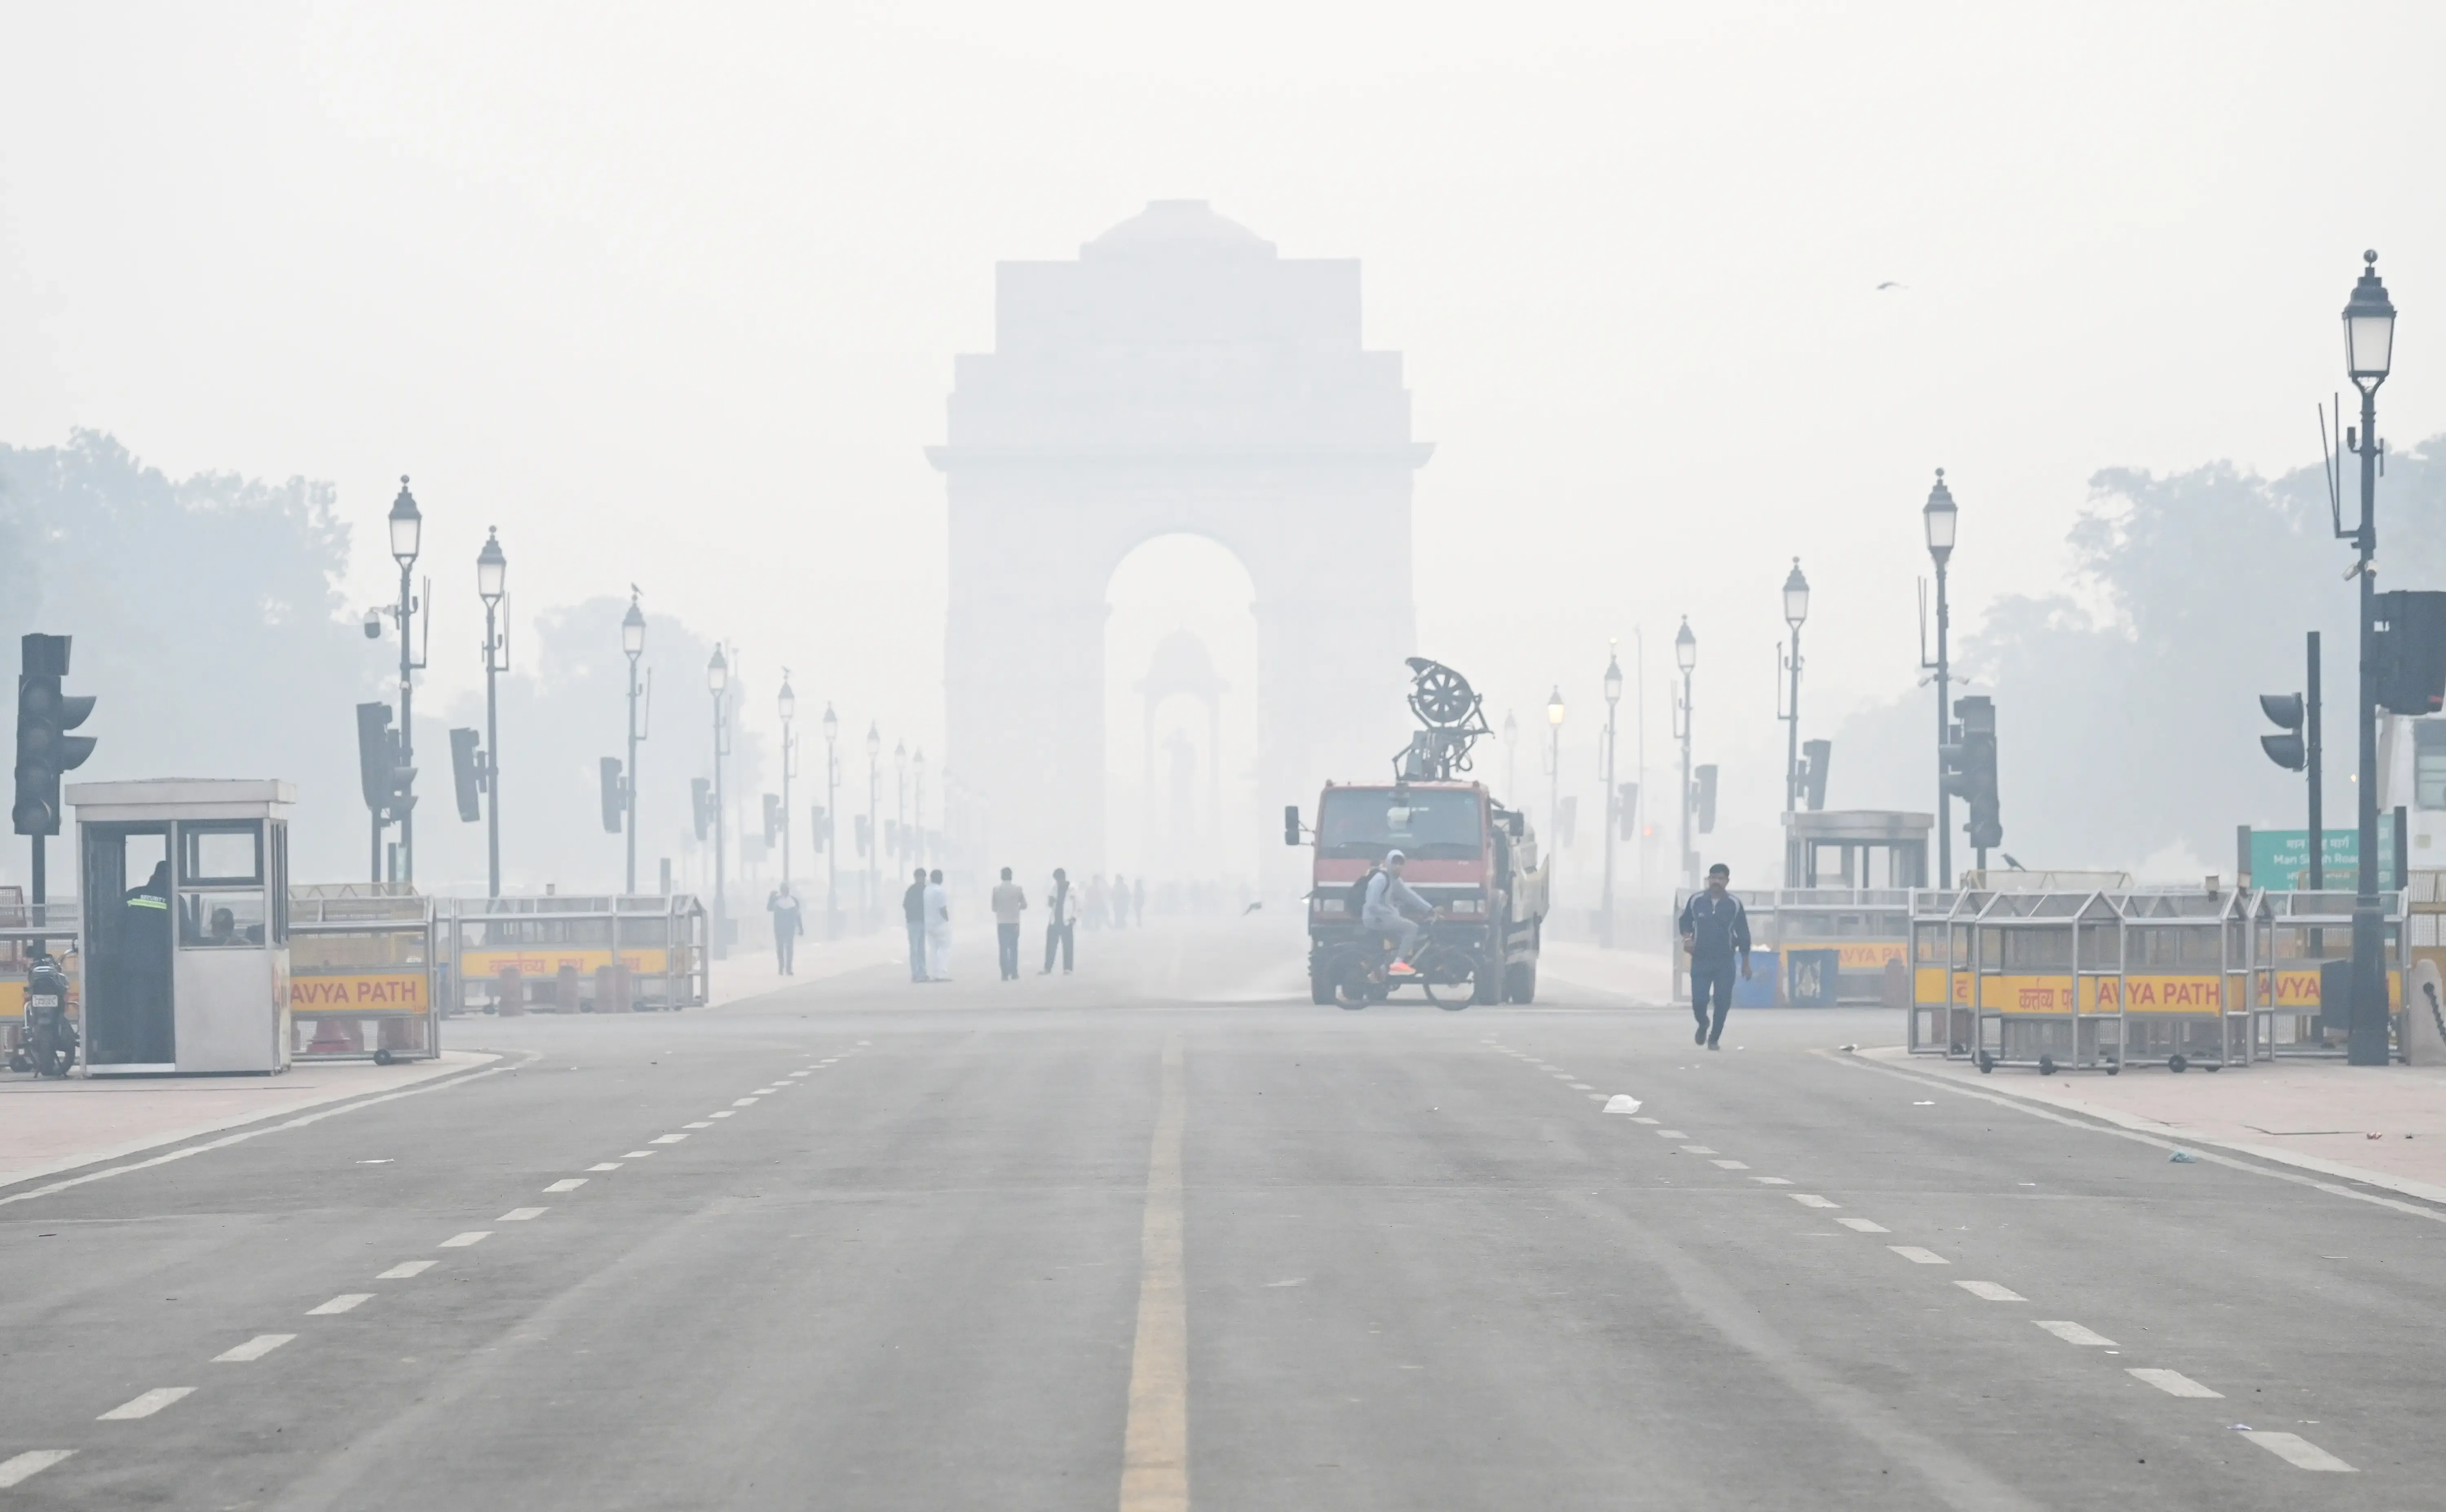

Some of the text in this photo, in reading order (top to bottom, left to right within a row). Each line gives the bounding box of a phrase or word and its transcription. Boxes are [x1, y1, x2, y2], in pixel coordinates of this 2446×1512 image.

[2274, 854, 2297, 864] Man
[357, 981, 416, 1002] PATH
[2163, 983, 2219, 1005] PATH
